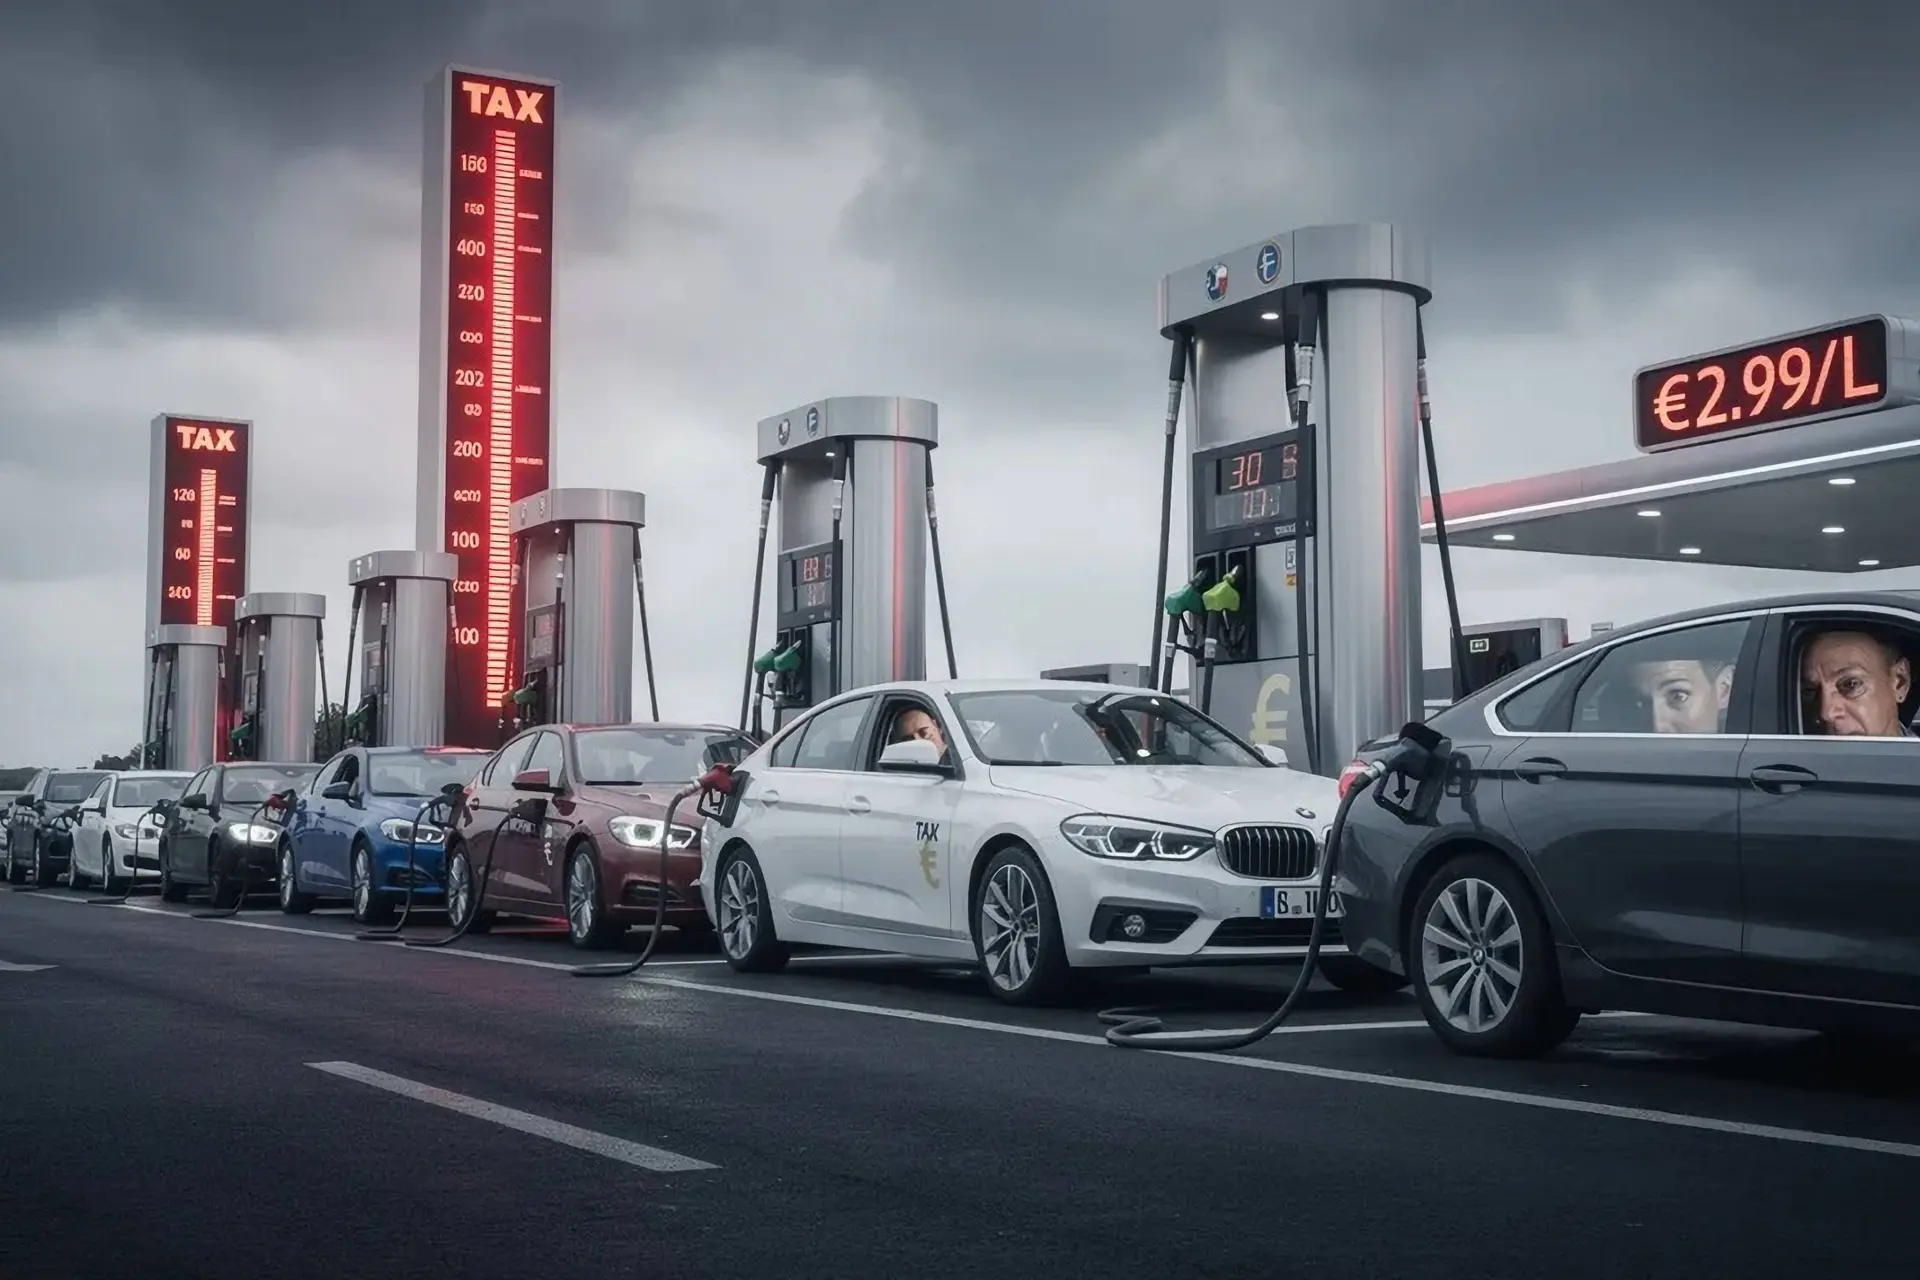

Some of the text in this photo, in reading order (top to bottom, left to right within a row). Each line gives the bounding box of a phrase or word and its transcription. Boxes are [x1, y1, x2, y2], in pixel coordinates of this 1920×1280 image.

[462, 81, 544, 124] TAX
[457, 239, 485, 257] 400
[1653, 335, 1879, 431] €2.99/L
[176, 425, 236, 452] TAX
[453, 440, 482, 458] 200
[451, 531, 480, 549] 100
[454, 627, 479, 645] 100
[916, 822, 939, 842] TAX
